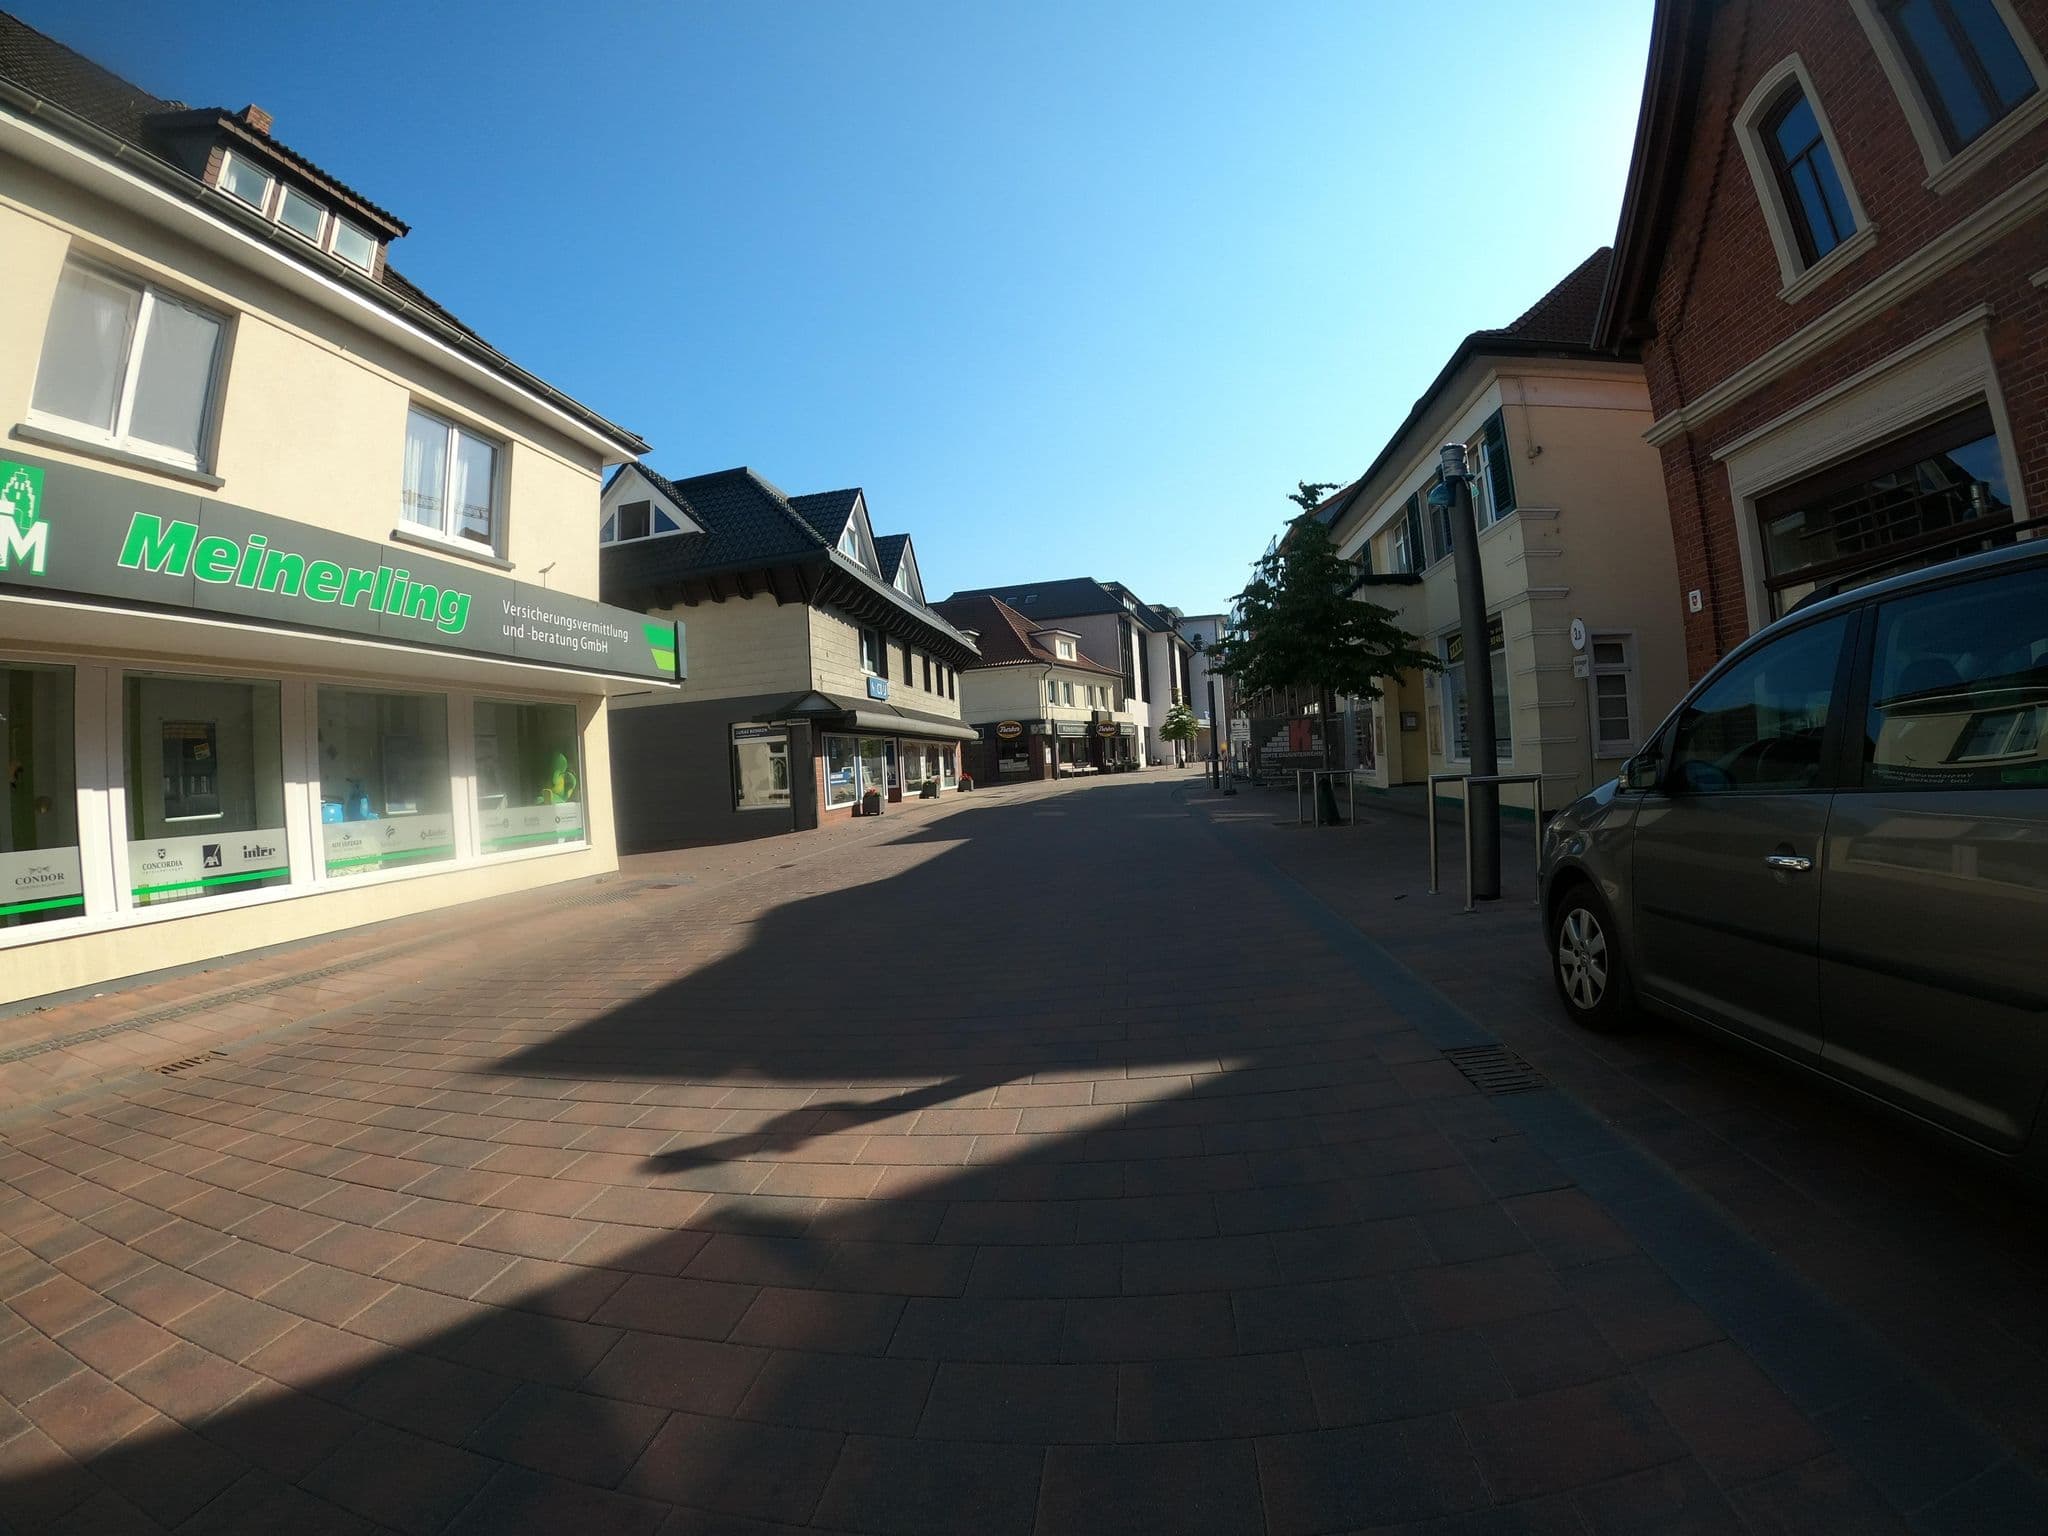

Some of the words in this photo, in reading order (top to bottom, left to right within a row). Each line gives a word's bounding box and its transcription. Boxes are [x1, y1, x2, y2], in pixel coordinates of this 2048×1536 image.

[118, 511, 472, 634] Meinerling
[502, 599, 629, 642] Versicherungsvermittlung
[503, 624, 525, 638] und
[527, 627, 578, 651] -beratung
[580, 637, 608, 653] GmbH
[243, 845, 276, 859] inter
[142, 860, 183, 871] CONCORDIA
[15, 872, 65, 886] CONDOR
